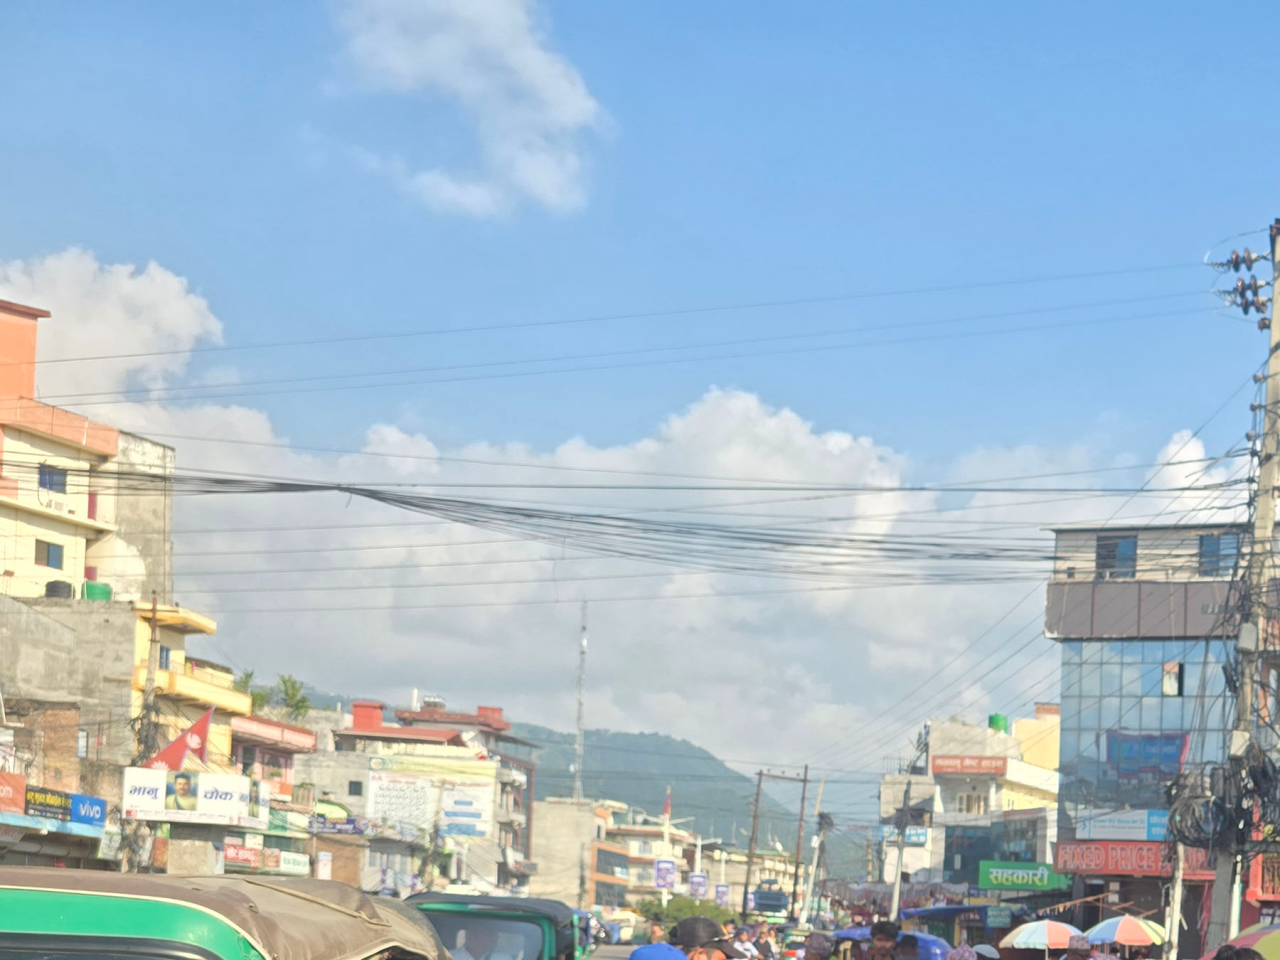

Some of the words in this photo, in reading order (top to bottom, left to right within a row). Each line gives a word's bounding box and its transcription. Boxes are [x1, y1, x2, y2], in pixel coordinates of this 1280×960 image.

[129, 785, 160, 800] भानु
[203, 786, 234, 801] चोक
[79, 801, 102, 819] vivo
[1058, 843, 1106, 871] FIXED
[1108, 844, 1155, 871] PRICE
[989, 866, 1049, 887] सहकारी
